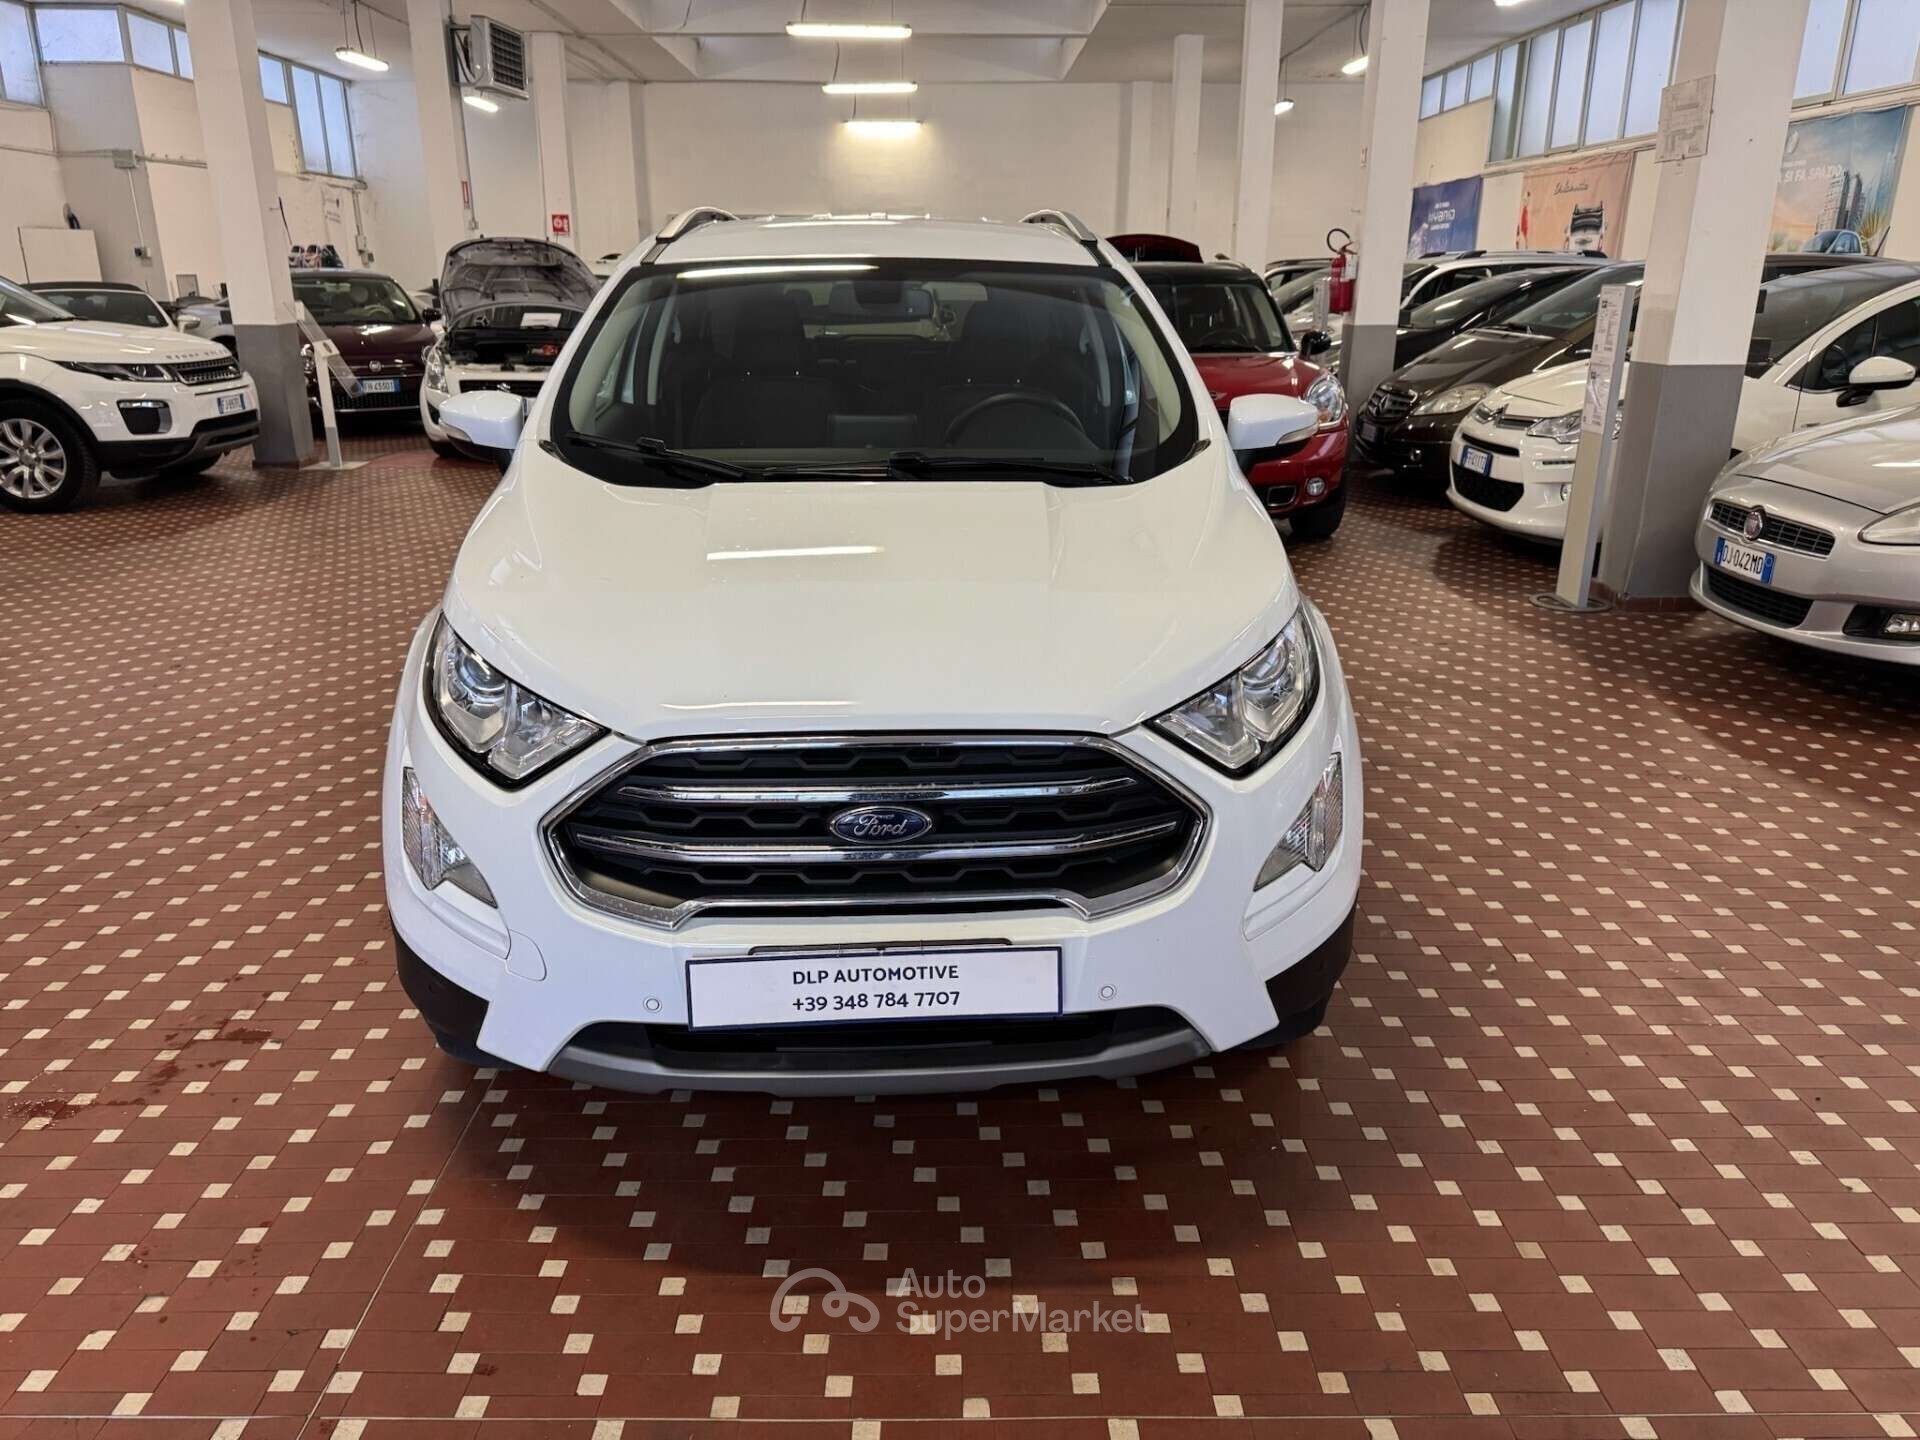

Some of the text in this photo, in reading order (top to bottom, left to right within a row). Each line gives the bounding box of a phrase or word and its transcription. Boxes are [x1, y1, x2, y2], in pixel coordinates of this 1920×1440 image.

[853, 813, 908, 837] Ford
[792, 965, 960, 985] DLP AUTOMOTIVE
[792, 991, 961, 1012] +39 348 784 7707
